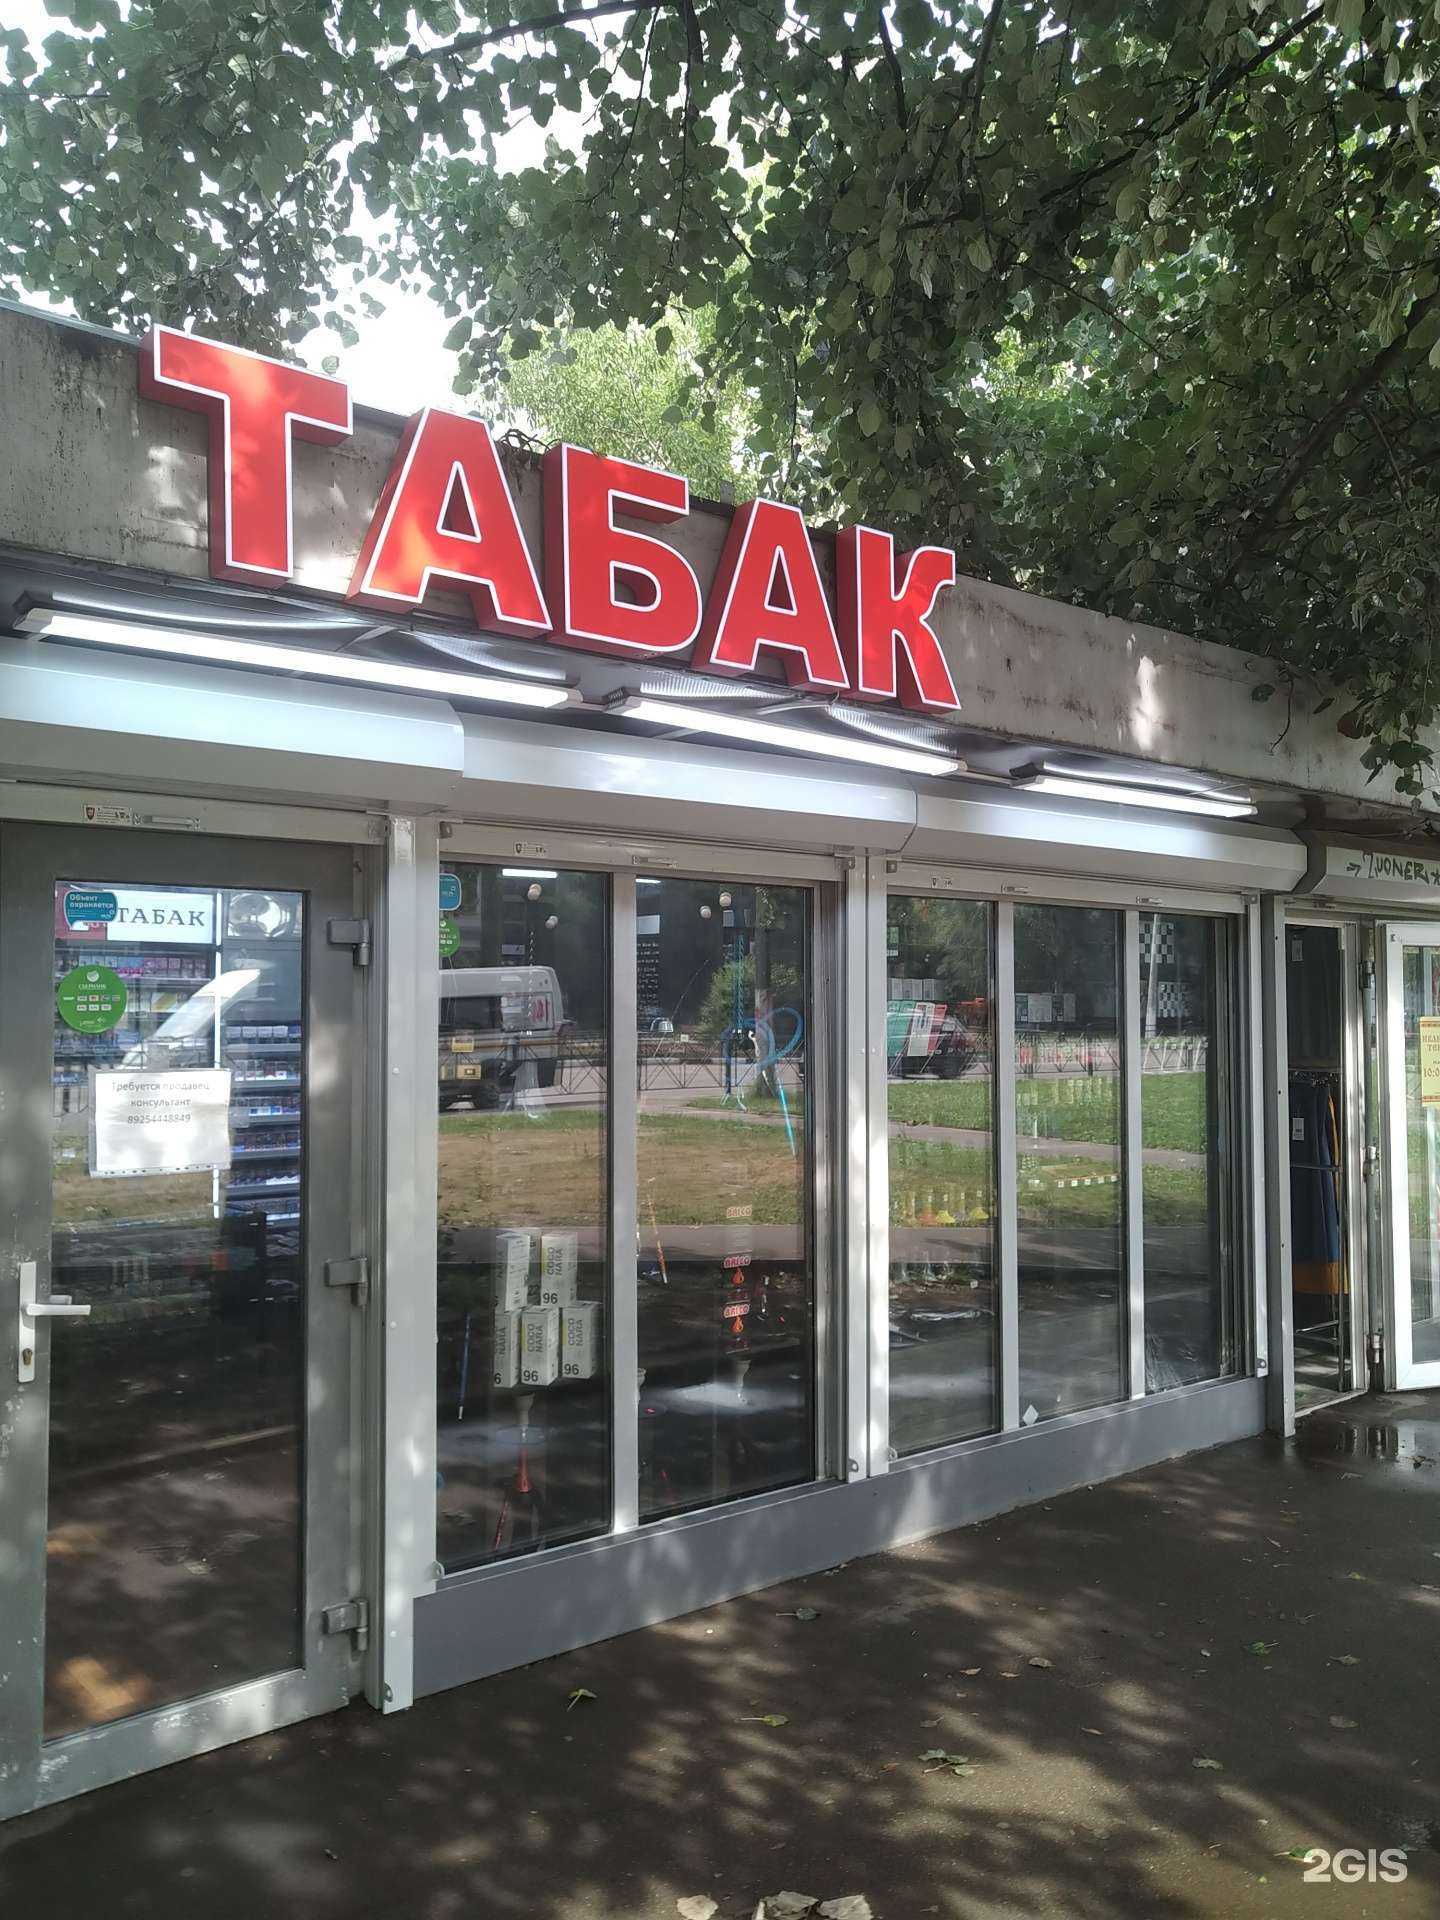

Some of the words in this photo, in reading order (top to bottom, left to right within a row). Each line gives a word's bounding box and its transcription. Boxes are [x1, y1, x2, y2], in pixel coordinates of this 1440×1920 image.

[142, 325, 961, 713] ТАБАК
[117, 907, 205, 927] ТАБАК
[112, 1081, 160, 1092] Требуется
[162, 1082, 210, 1092] продавец
[130, 1099, 192, 1109] консультант
[725, 1255, 751, 1268] BRICO
[543, 1292, 558, 1305] 96
[523, 1369, 538, 1382] 96
[564, 1363, 579, 1376] 96
